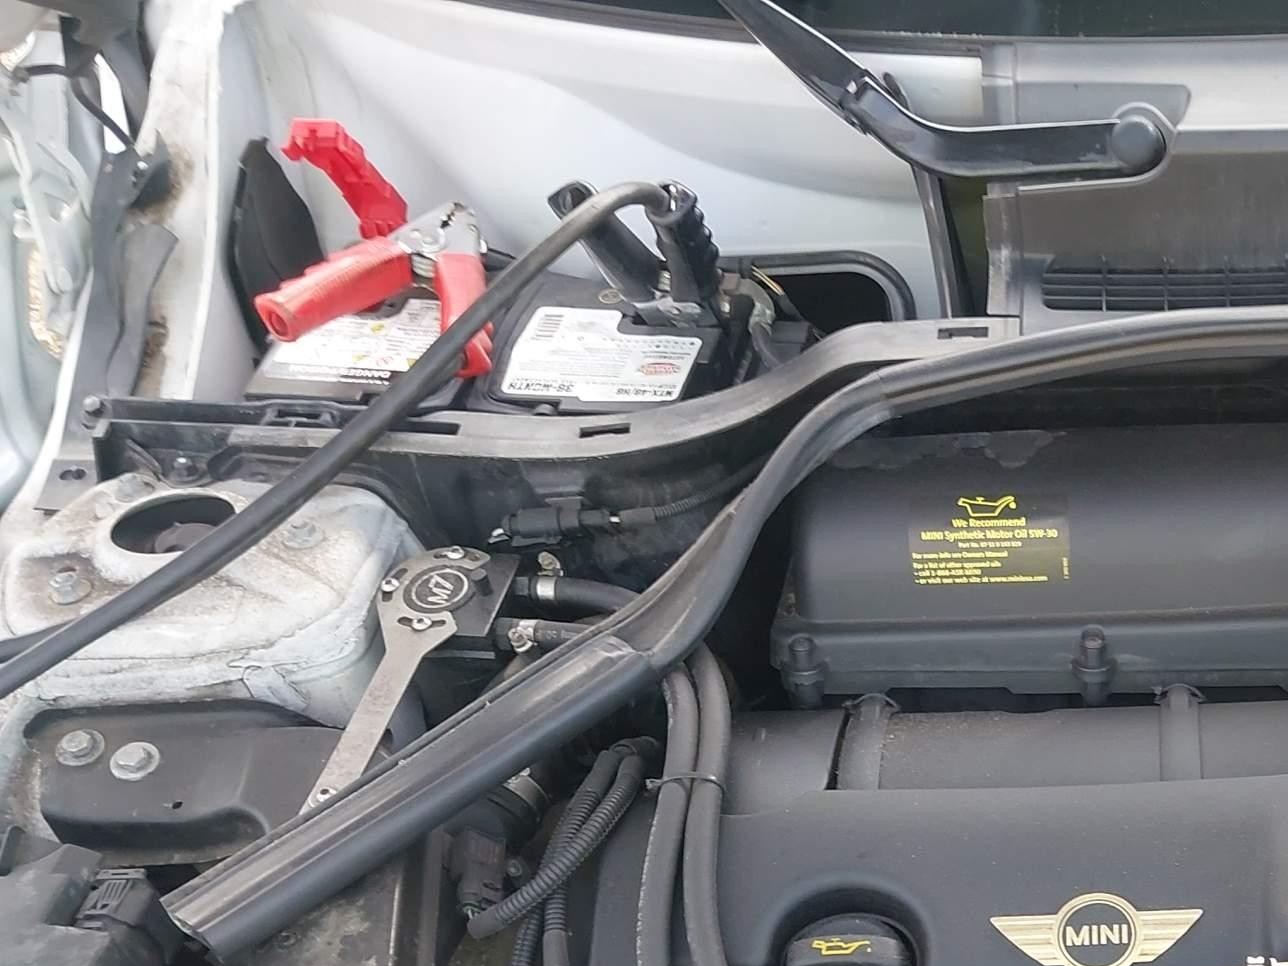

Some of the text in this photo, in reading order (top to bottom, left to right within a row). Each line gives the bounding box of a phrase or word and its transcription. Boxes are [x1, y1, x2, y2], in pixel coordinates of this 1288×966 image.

[952, 517, 1026, 528] We Recommend
[945, 530, 986, 543] Synthetic
[986, 529, 1014, 539] Motor
[1014, 529, 1028, 539] Oil
[426, 574, 455, 605] M7
[1065, 923, 1129, 947] MINI
